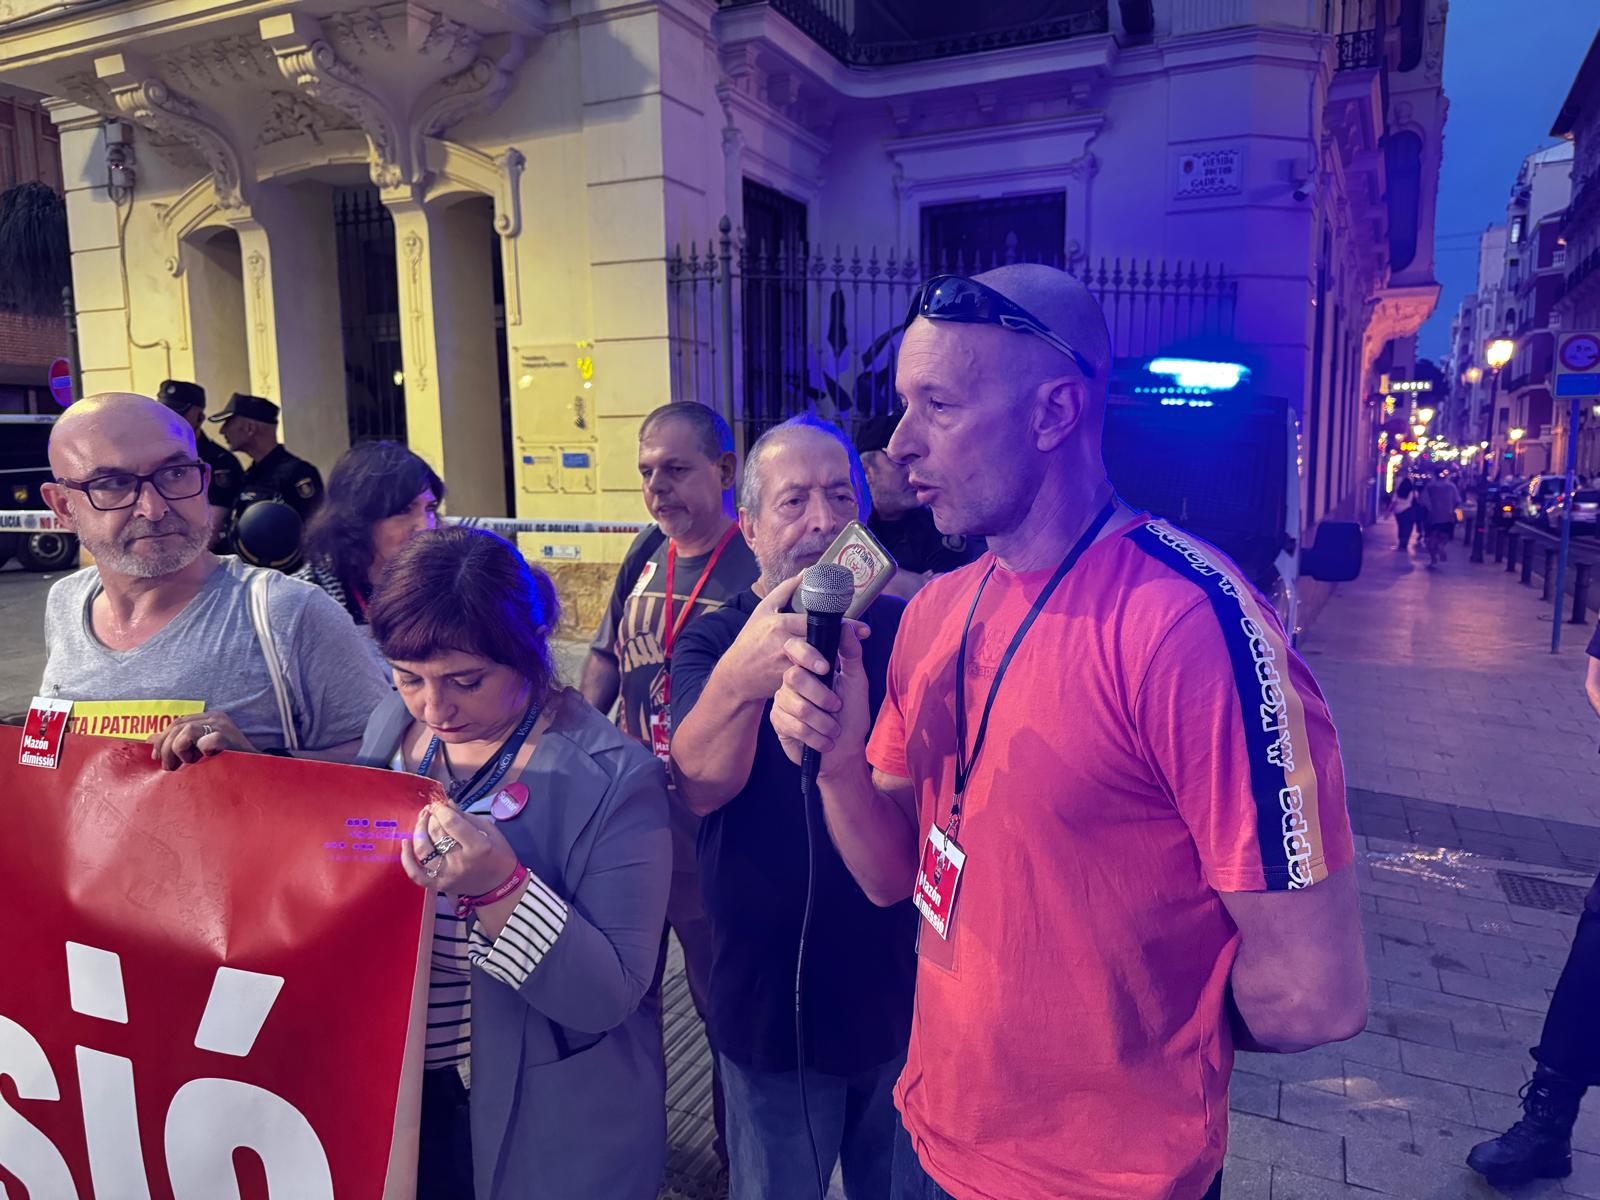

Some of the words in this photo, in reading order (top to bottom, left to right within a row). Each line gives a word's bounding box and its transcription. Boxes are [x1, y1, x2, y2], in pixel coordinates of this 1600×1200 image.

[100, 713, 182, 735] PATRIMO
[24, 734, 49, 750] Mazón
[22, 752, 55, 767] dimissió
[918, 869, 942, 908] Mazón
